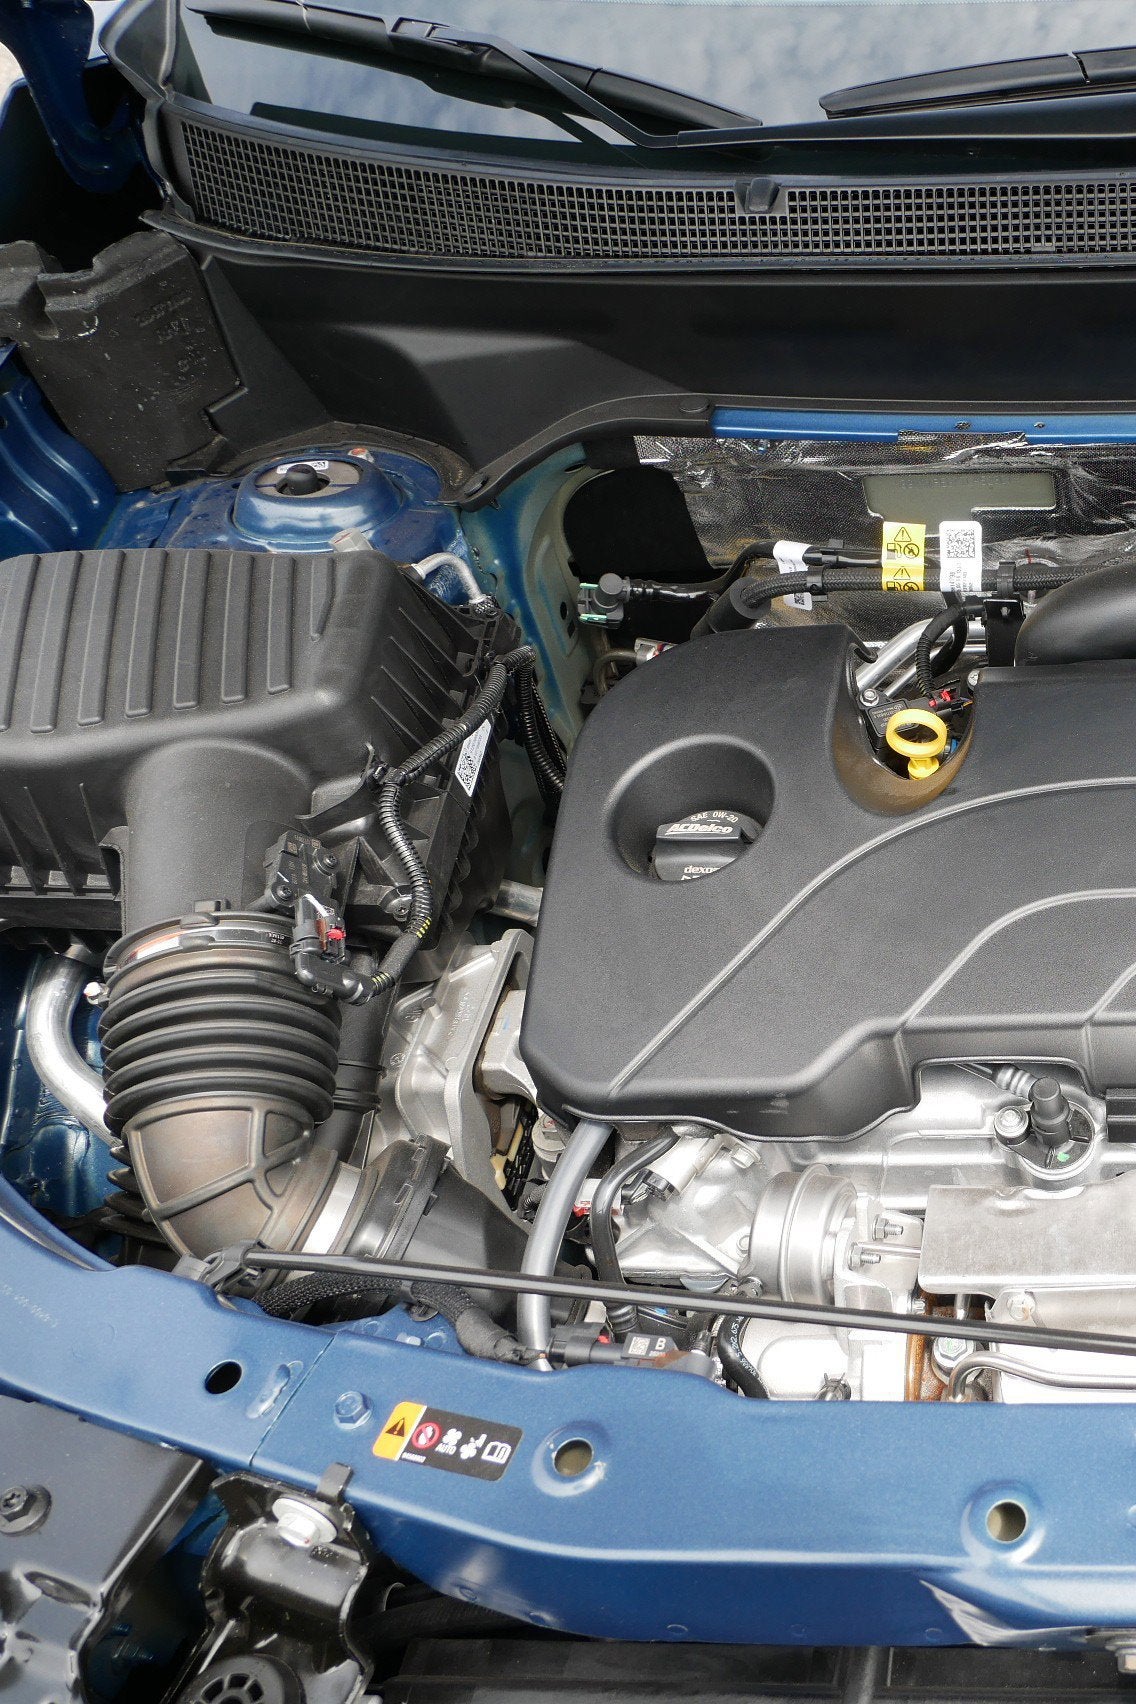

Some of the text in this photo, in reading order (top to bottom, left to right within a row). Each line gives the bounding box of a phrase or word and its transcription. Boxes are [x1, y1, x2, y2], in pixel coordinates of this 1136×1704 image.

[690, 811, 739, 823] SAE 0W-20
[666, 823, 734, 835] ACDelco
[655, 1337, 667, 1351] B
[435, 1443, 457, 1455] AUTO
